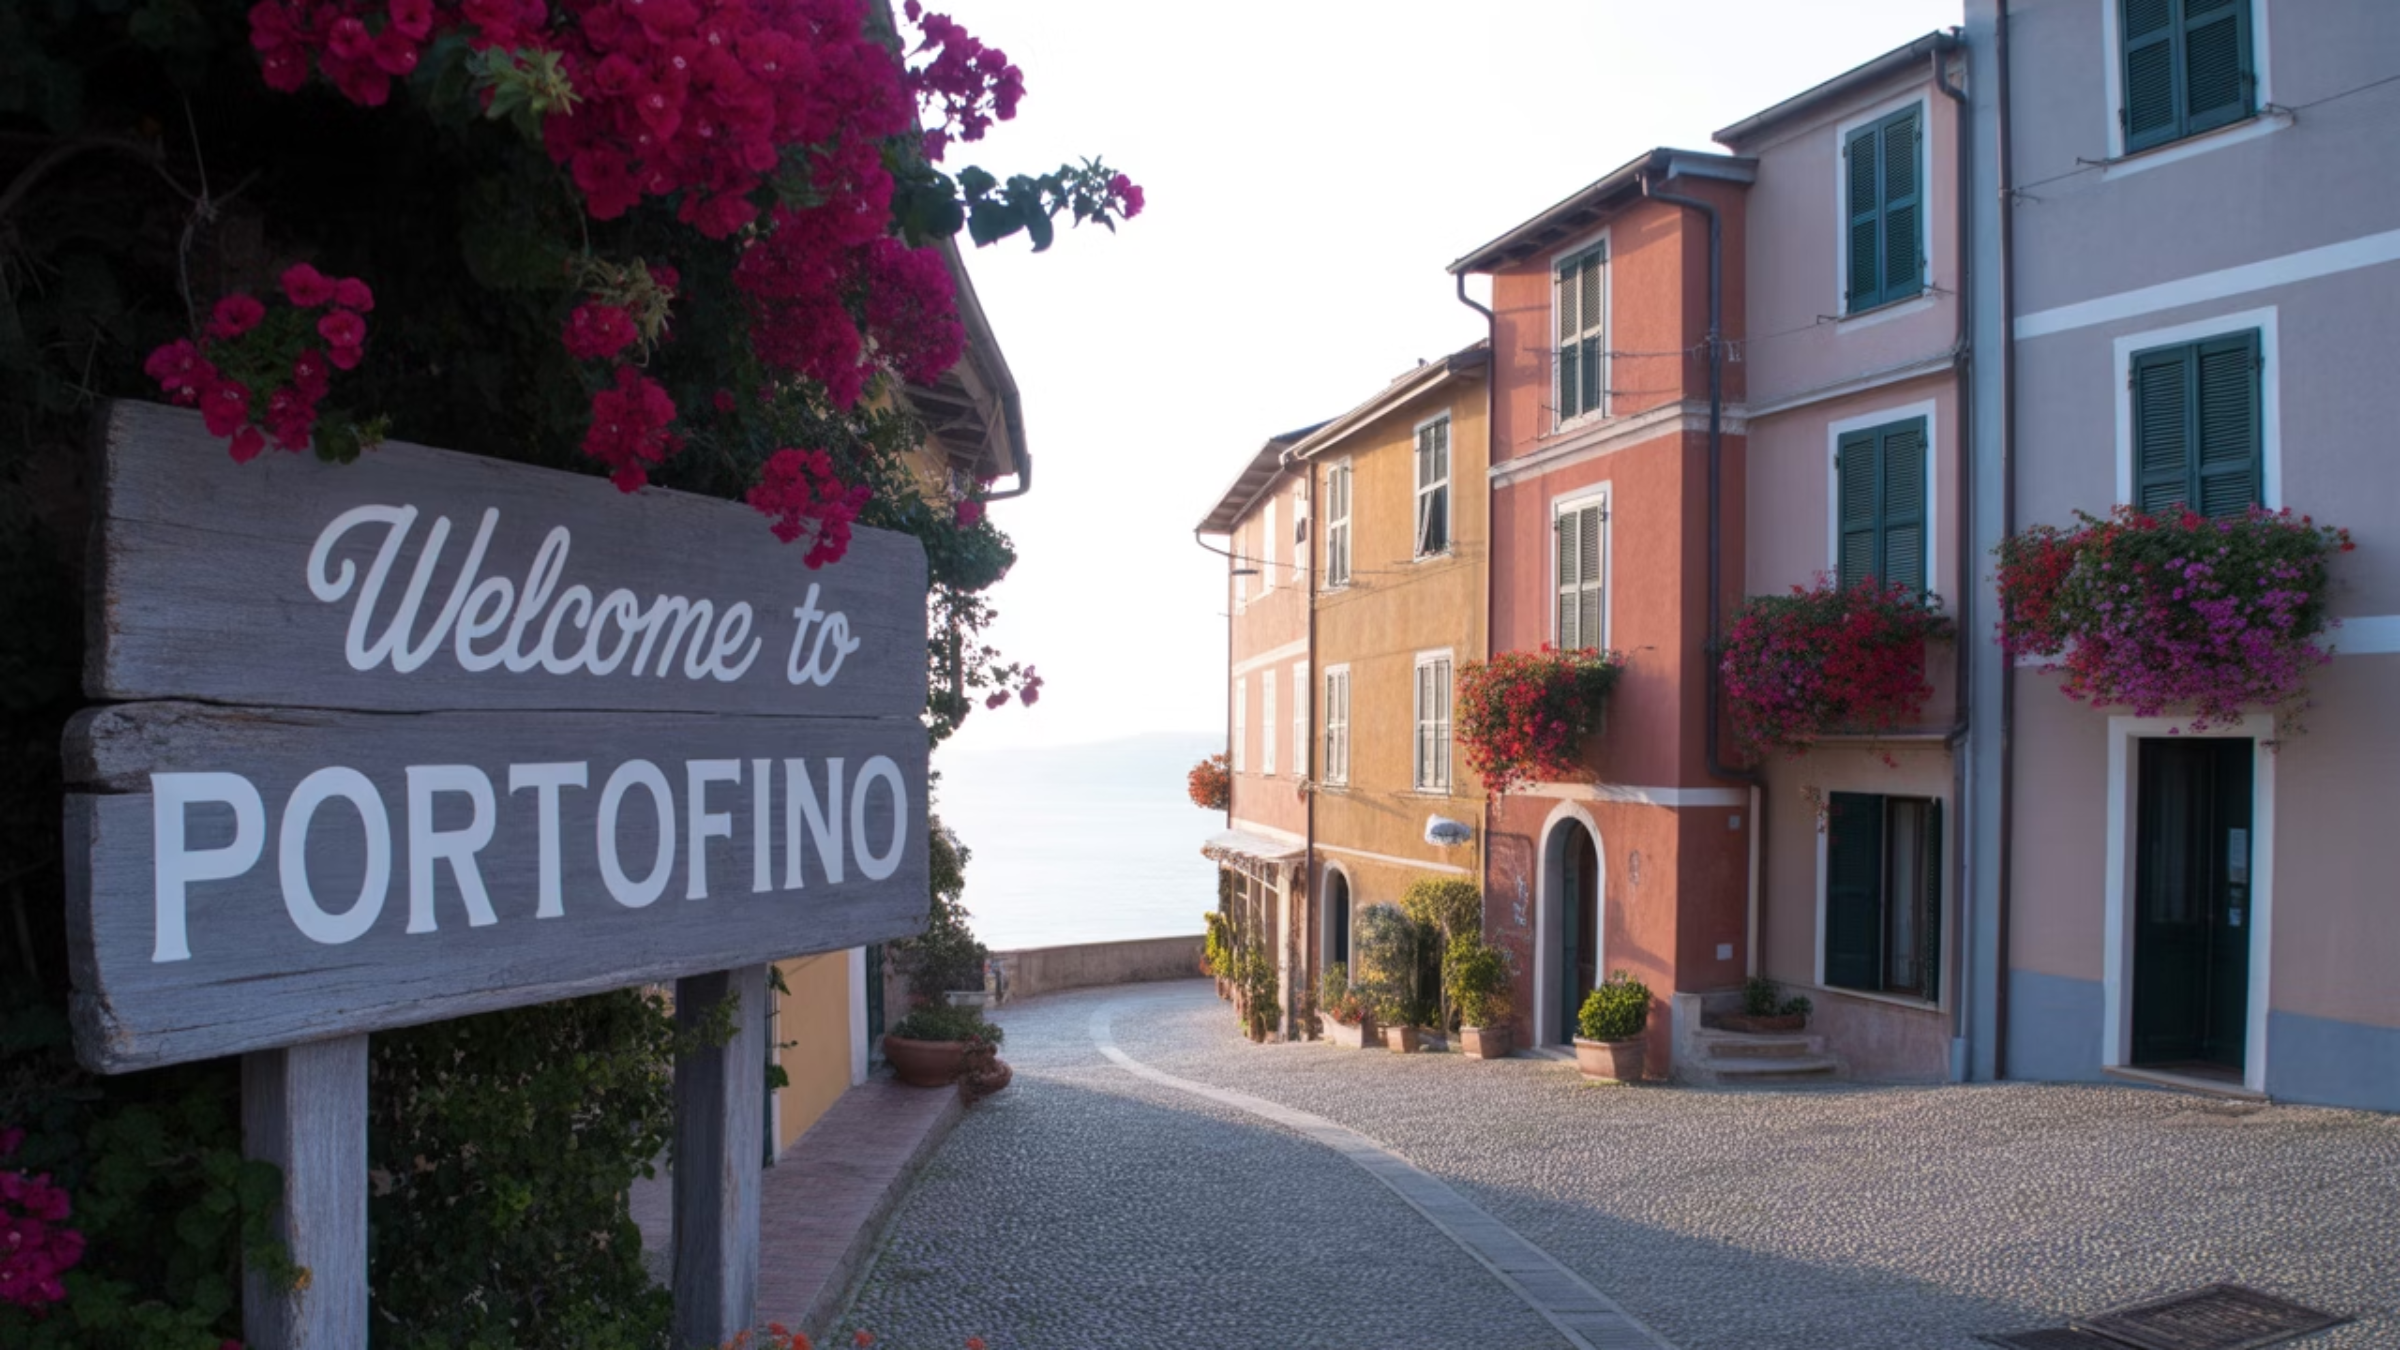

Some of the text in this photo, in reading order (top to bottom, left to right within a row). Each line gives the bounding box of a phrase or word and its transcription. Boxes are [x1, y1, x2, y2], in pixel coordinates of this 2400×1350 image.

[307, 504, 860, 687] Welcome to
[150, 755, 909, 963] PORTOFINO
